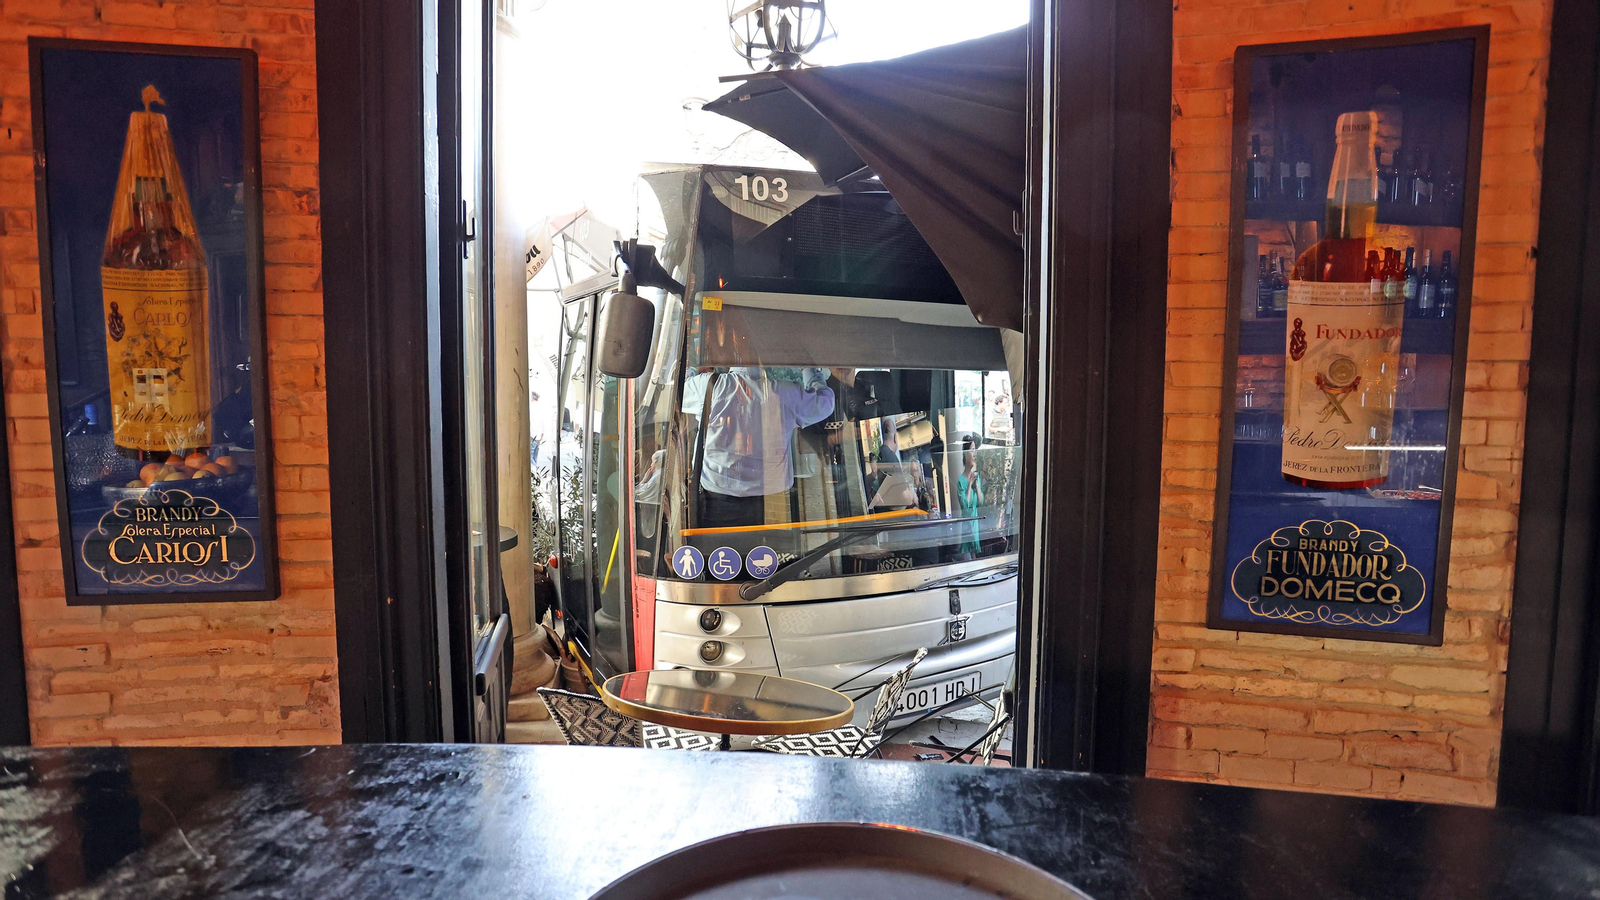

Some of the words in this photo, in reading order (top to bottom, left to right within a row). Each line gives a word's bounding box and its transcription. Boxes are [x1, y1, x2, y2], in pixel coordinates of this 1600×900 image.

[734, 174, 789, 203] 103
[527, 258, 545, 275] 1890
[1315, 324, 1402, 340] FUNDADOR
[1283, 425, 1323, 449] Pedro
[1283, 460, 1308, 471] JEREZ
[1309, 465, 1320, 473] DE
[1329, 463, 1380, 474] FRONTERA
[136, 507, 201, 522] BRANDY
[120, 524, 161, 537] Solera
[163, 523, 216, 540] Especial
[108, 535, 219, 566] CARLOS
[1299, 538, 1359, 552] BRANDY
[1266, 549, 1392, 580] FUNDADOR
[1260, 576, 1401, 604] DOMECQ
